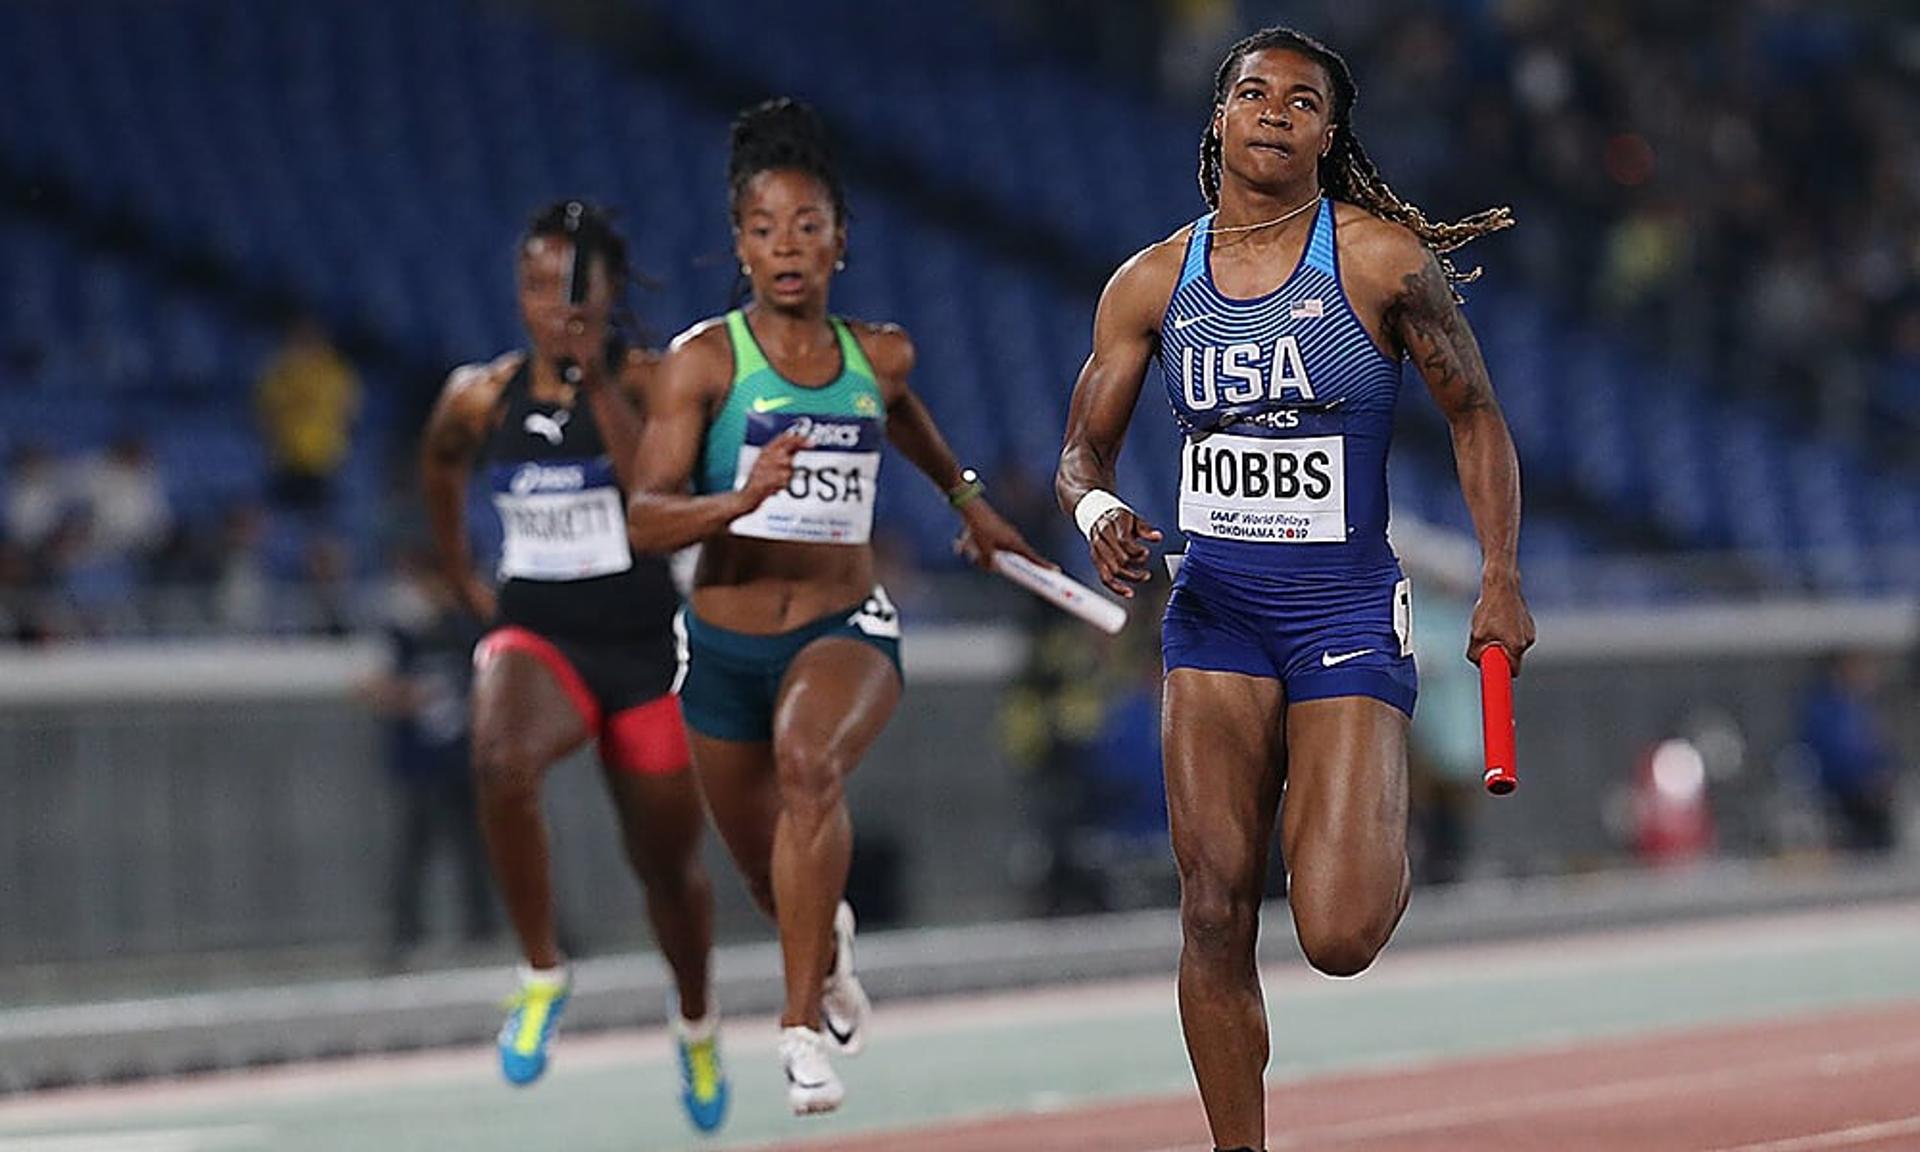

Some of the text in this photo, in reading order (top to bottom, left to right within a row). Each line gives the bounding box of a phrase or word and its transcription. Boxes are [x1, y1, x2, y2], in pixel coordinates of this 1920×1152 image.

[1182, 335, 1316, 411] USA
[1190, 444, 1332, 501] HOBBS
[1210, 522, 1309, 539] YOKOHAMA 2019
[1242, 513, 1274, 525] World
